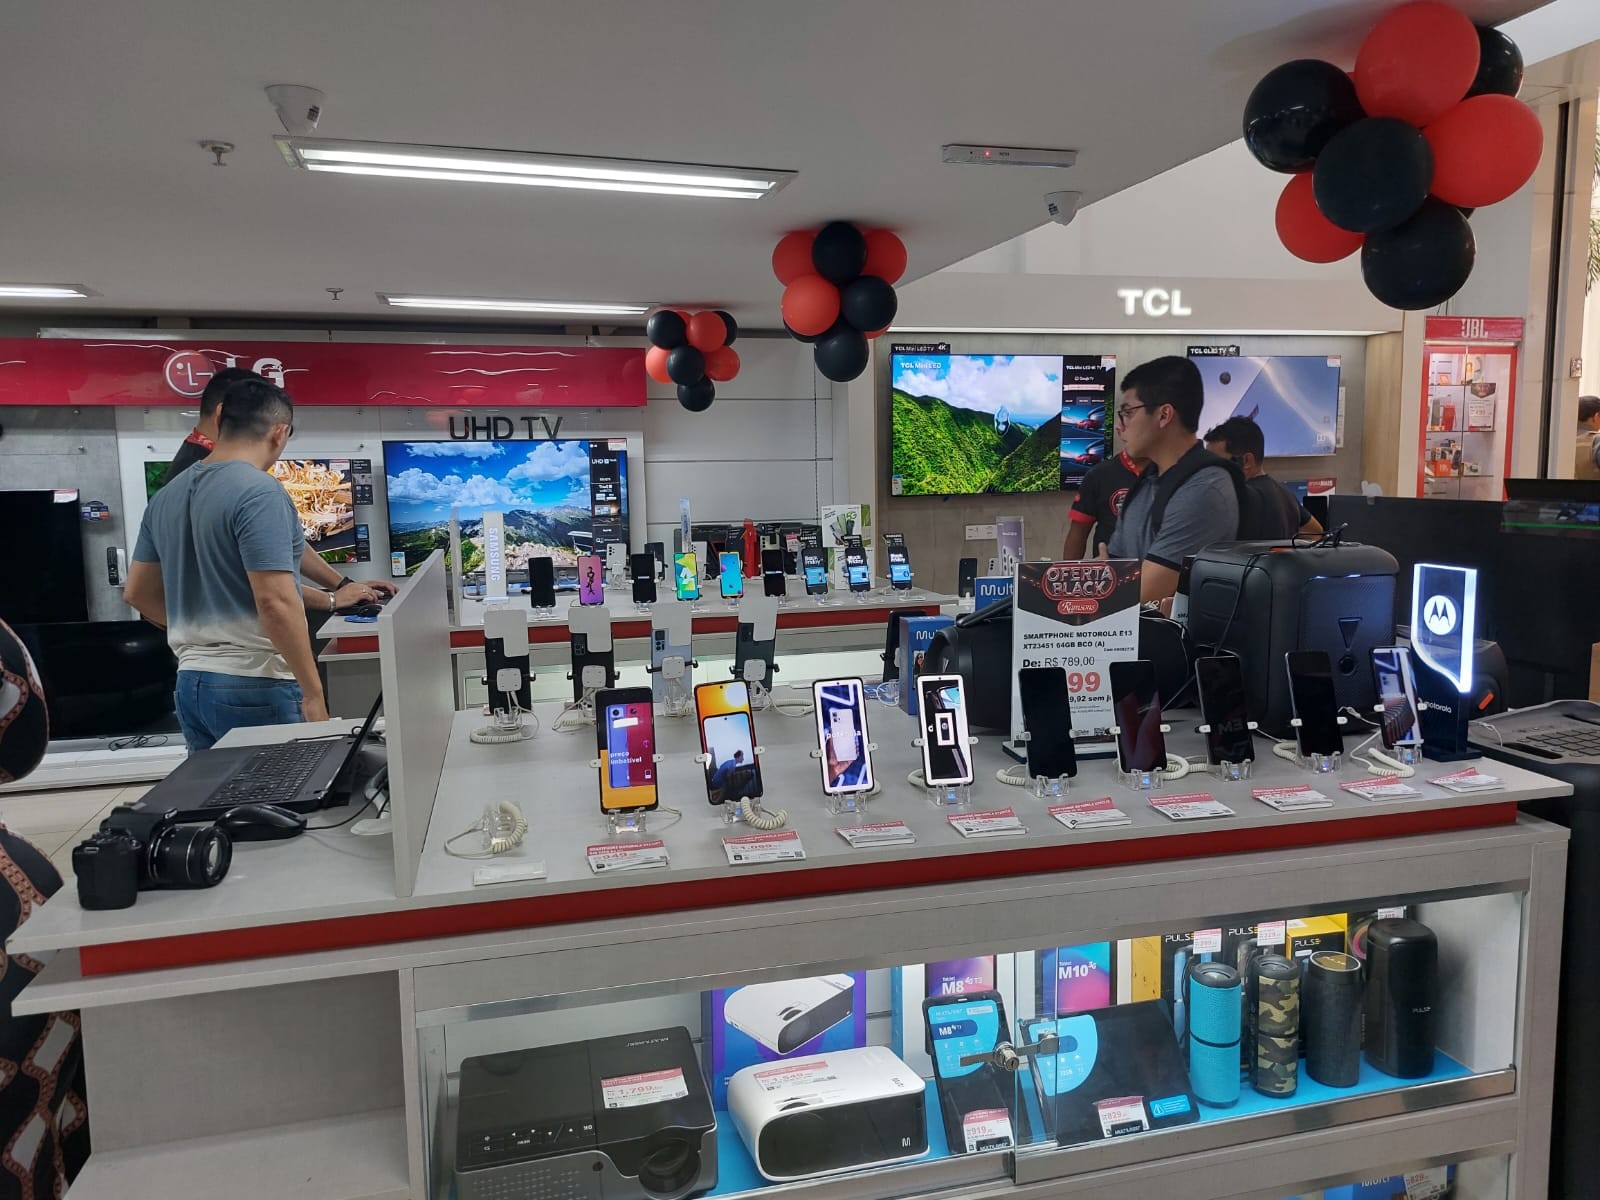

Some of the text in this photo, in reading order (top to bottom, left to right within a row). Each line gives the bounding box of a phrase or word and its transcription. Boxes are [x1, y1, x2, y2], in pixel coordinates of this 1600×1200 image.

[1117, 288, 1192, 316] TCL
[1461, 318, 1488, 338] JBL
[450, 416, 563, 440] UHD TV
[489, 527, 500, 581] SAMSUNG
[1046, 567, 1114, 583] OFERTA
[1052, 581, 1107, 597] BLACK
[1023, 632, 1074, 640] SMARTPHONE
[1022, 656, 1095, 668] De: R$ 789,00
[1294, 938, 1322, 947] PULSE
[1058, 961, 1097, 980] M10 3G
[942, 981, 965, 995] M8
[939, 1027, 953, 1036] M8
